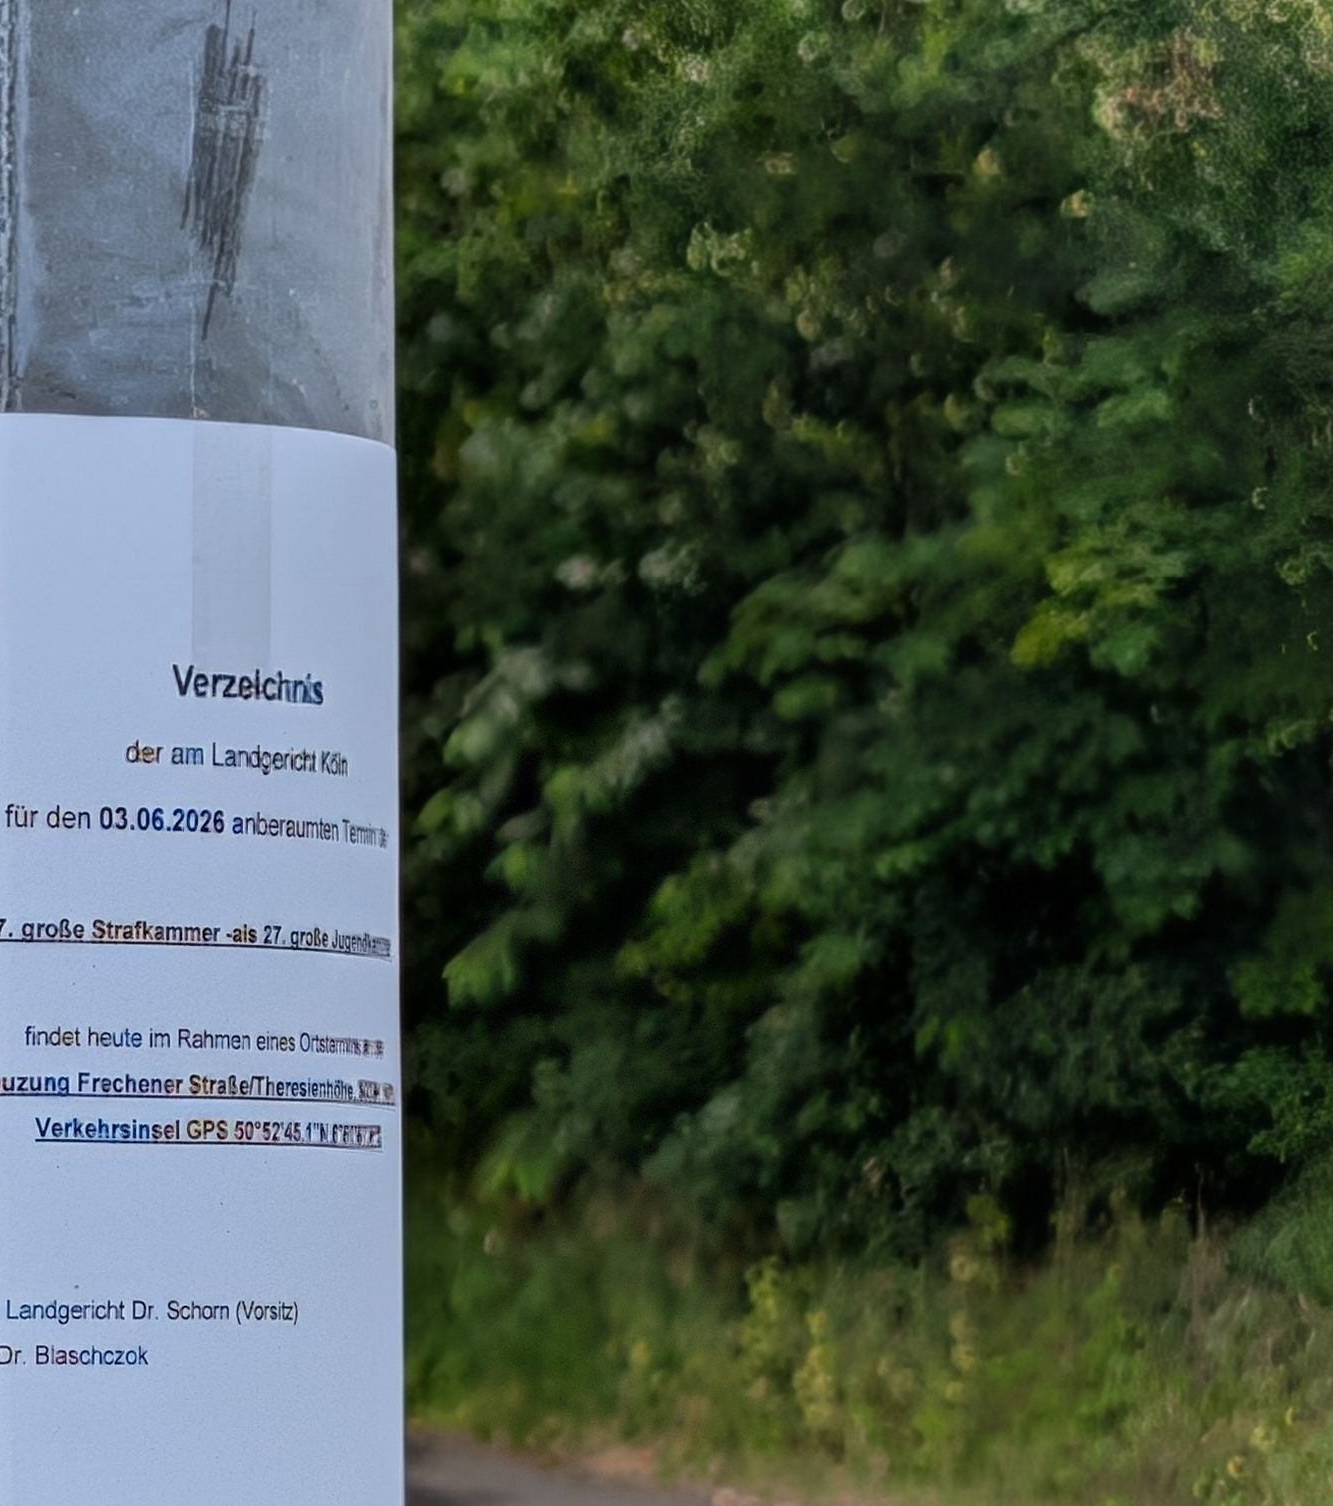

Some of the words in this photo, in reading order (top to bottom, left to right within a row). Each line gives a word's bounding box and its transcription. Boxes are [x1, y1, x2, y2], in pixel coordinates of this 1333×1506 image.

[172, 664, 325, 705] Verzeichnis
[125, 740, 164, 764] der
[171, 746, 204, 766] am
[212, 742, 316, 774] Landgericht
[321, 752, 349, 777] Köln
[5, 804, 38, 829] für
[46, 805, 91, 830] den
[99, 806, 226, 834] 03.06.2026
[232, 811, 340, 842] anberaumten
[22, 917, 85, 945] große
[92, 919, 221, 943] Strafkammer
[226, 924, 258, 944] -als
[264, 925, 287, 945] 27.
[291, 927, 330, 949] große
[24, 1025, 81, 1049] findet
[88, 1027, 143, 1050] heute
[149, 1028, 171, 1050] im
[178, 1029, 251, 1052] Rahmen
[256, 1031, 296, 1052] eines
[78, 1073, 183, 1096] Frechener
[35, 1117, 180, 1142] Verkehrsinsel
[186, 1120, 229, 1140] GPS
[6, 1299, 125, 1325] Landgericht
[133, 1301, 159, 1321] Dr.
[167, 1300, 230, 1322] Schorn
[236, 1300, 299, 1326] (Vorsitz)
[35, 1345, 149, 1366] Blaschczok
